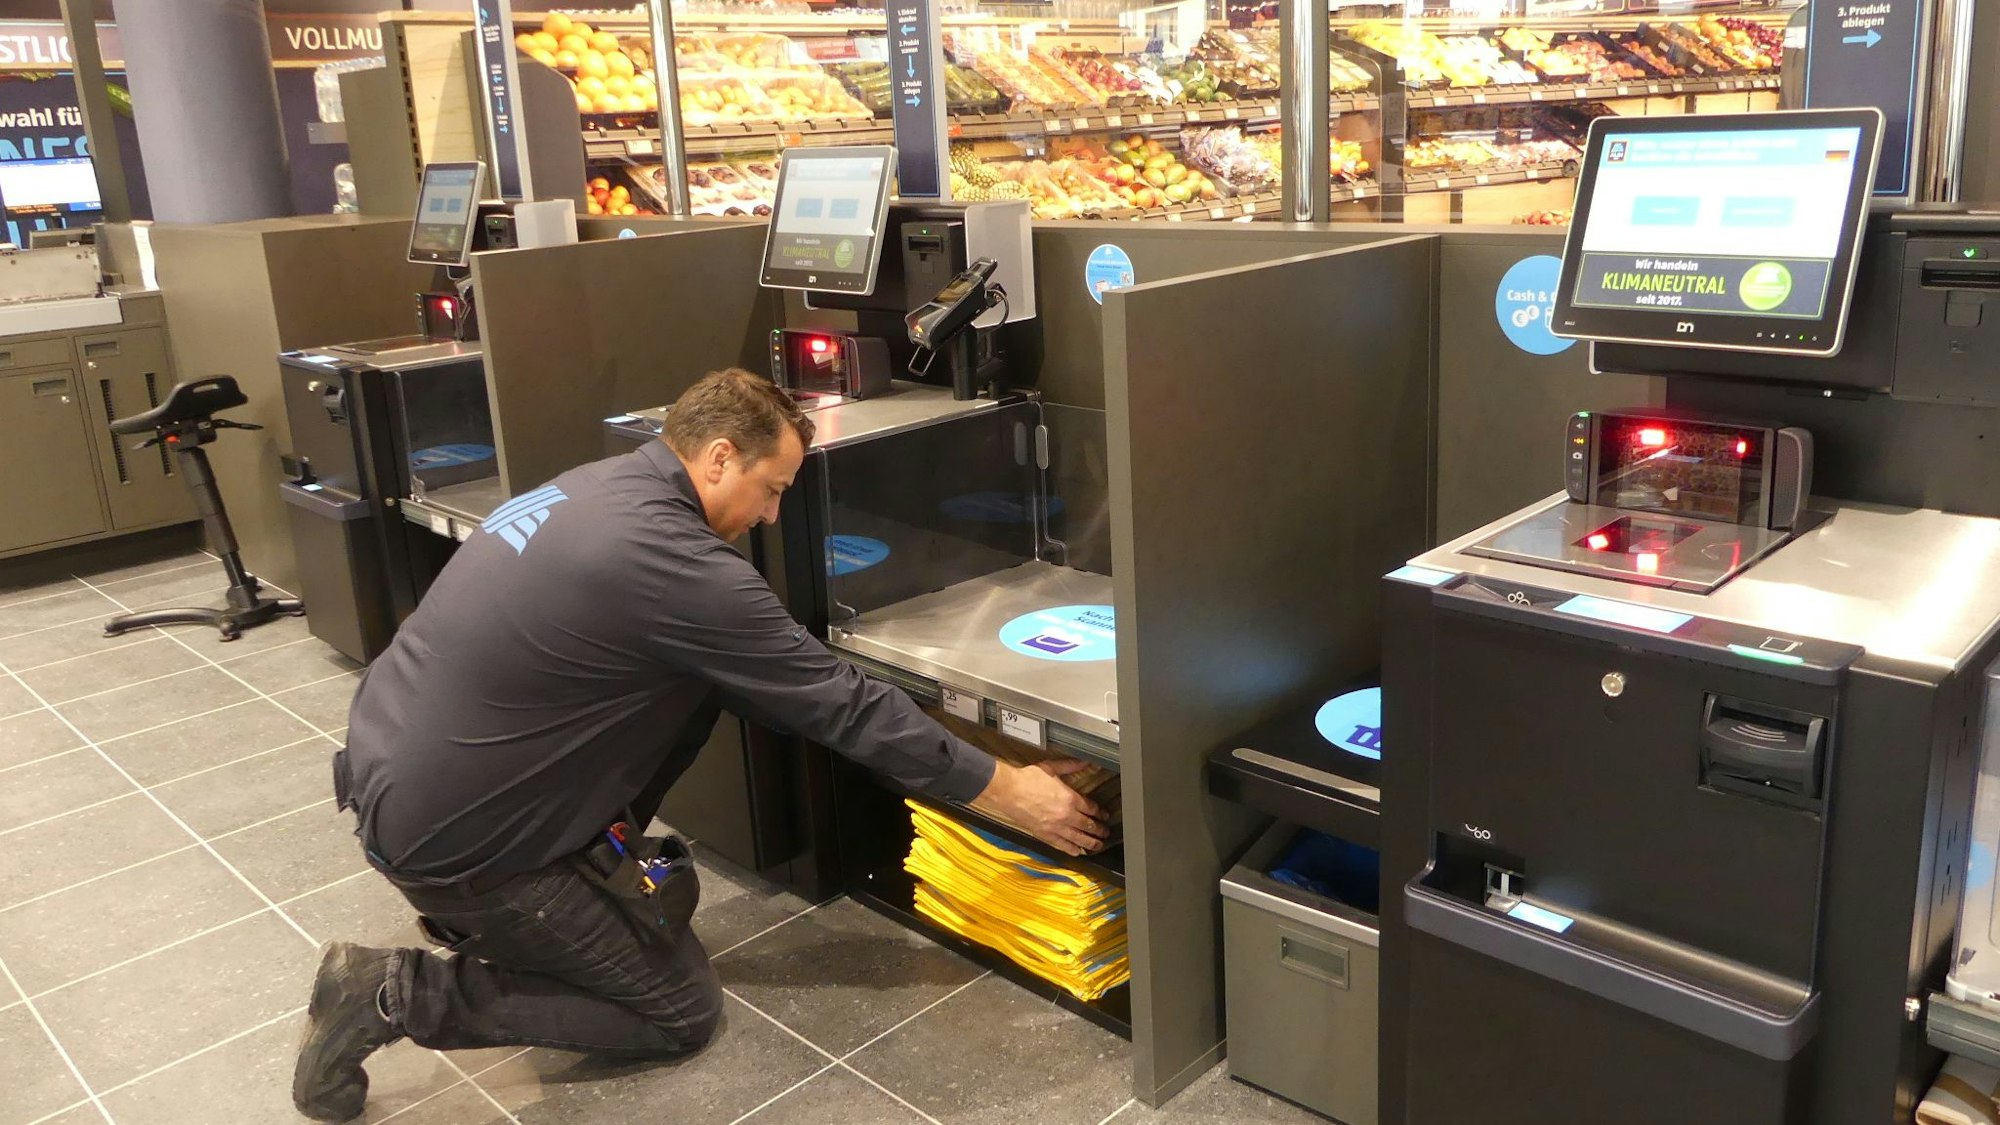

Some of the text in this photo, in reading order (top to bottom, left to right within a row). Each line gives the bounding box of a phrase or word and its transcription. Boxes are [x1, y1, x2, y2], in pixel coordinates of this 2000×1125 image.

[1838, 4, 1891, 17] 3. Produkt
[1842, 17, 1885, 28] ablegen
[284, 27, 383, 50] VOLLMU
[0, 107, 53, 127] wahl
[1635, 259, 1698, 271] Wir handeln
[1601, 272, 1726, 295] KLIMANEUTRAL
[1507, 289, 1535, 301] Cash
[1538, 291, 1547, 302] &
[1636, 294, 1682, 306] seit 2017.
